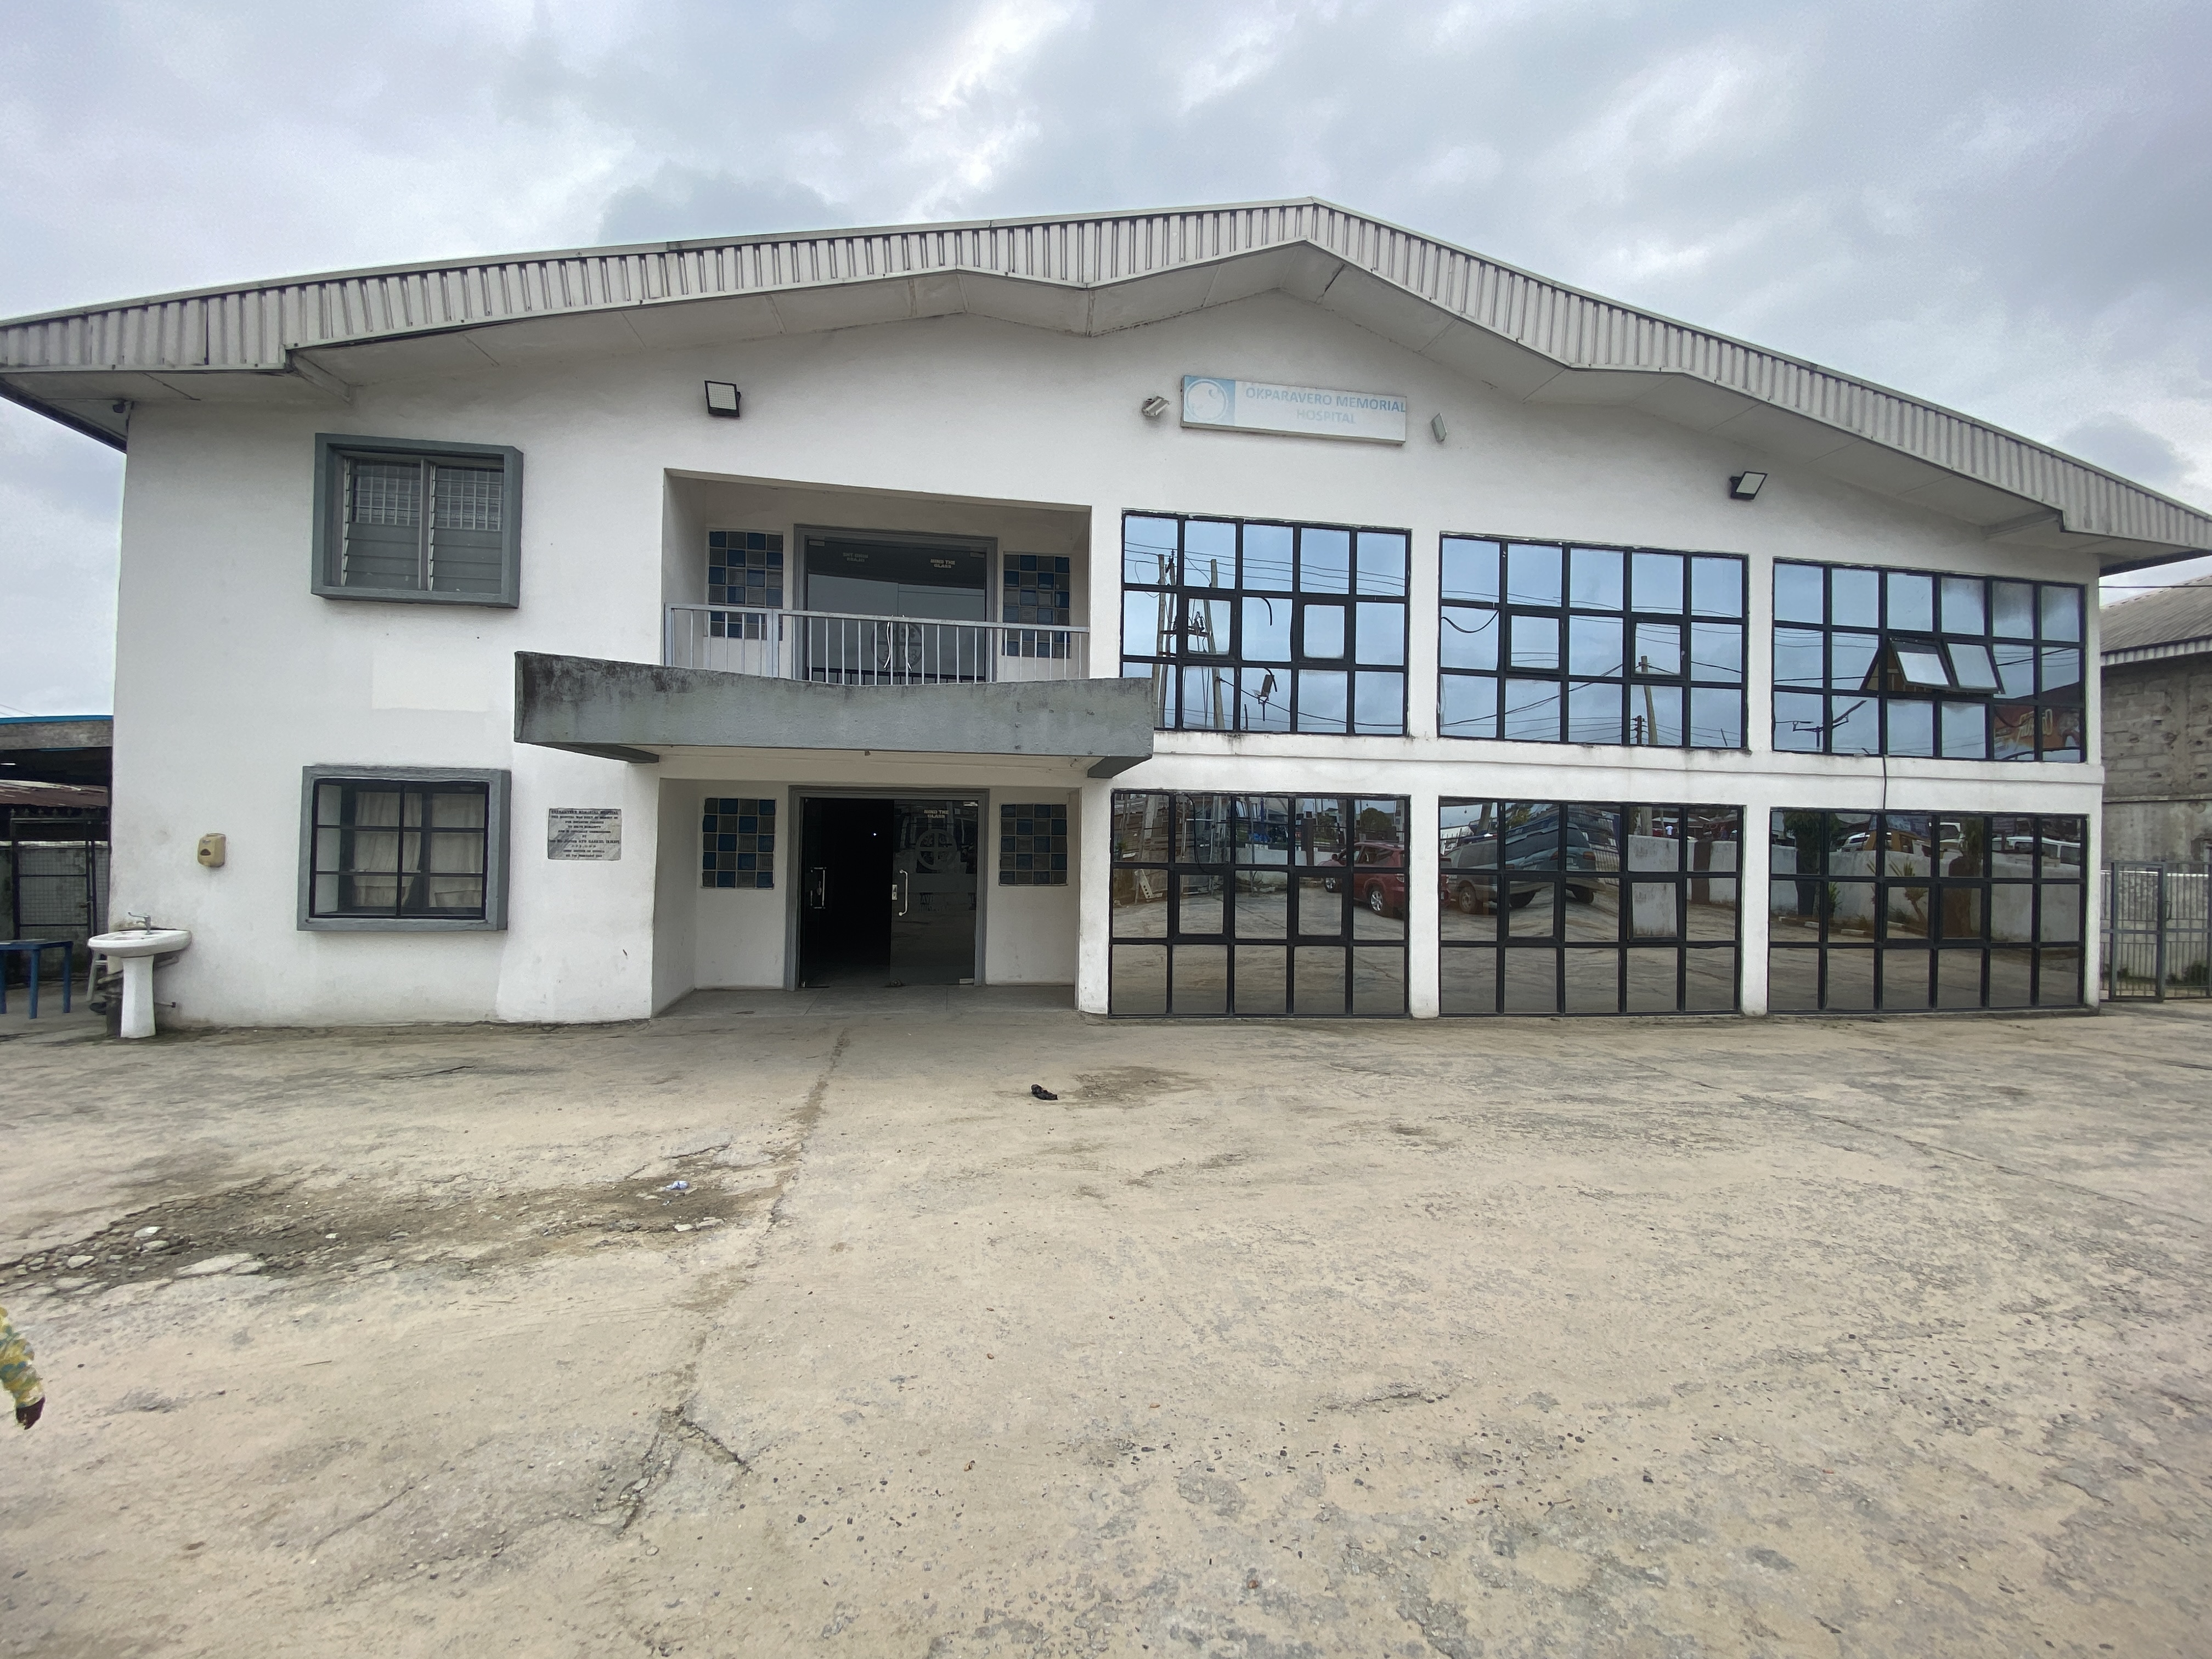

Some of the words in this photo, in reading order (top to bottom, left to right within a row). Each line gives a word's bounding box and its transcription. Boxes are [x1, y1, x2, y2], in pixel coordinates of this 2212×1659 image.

[1246, 387, 1332, 405] OKPARAVERO
[1336, 396, 1406, 413] MEMORIAL
[1296, 409, 1356, 425] HOSPITAL
